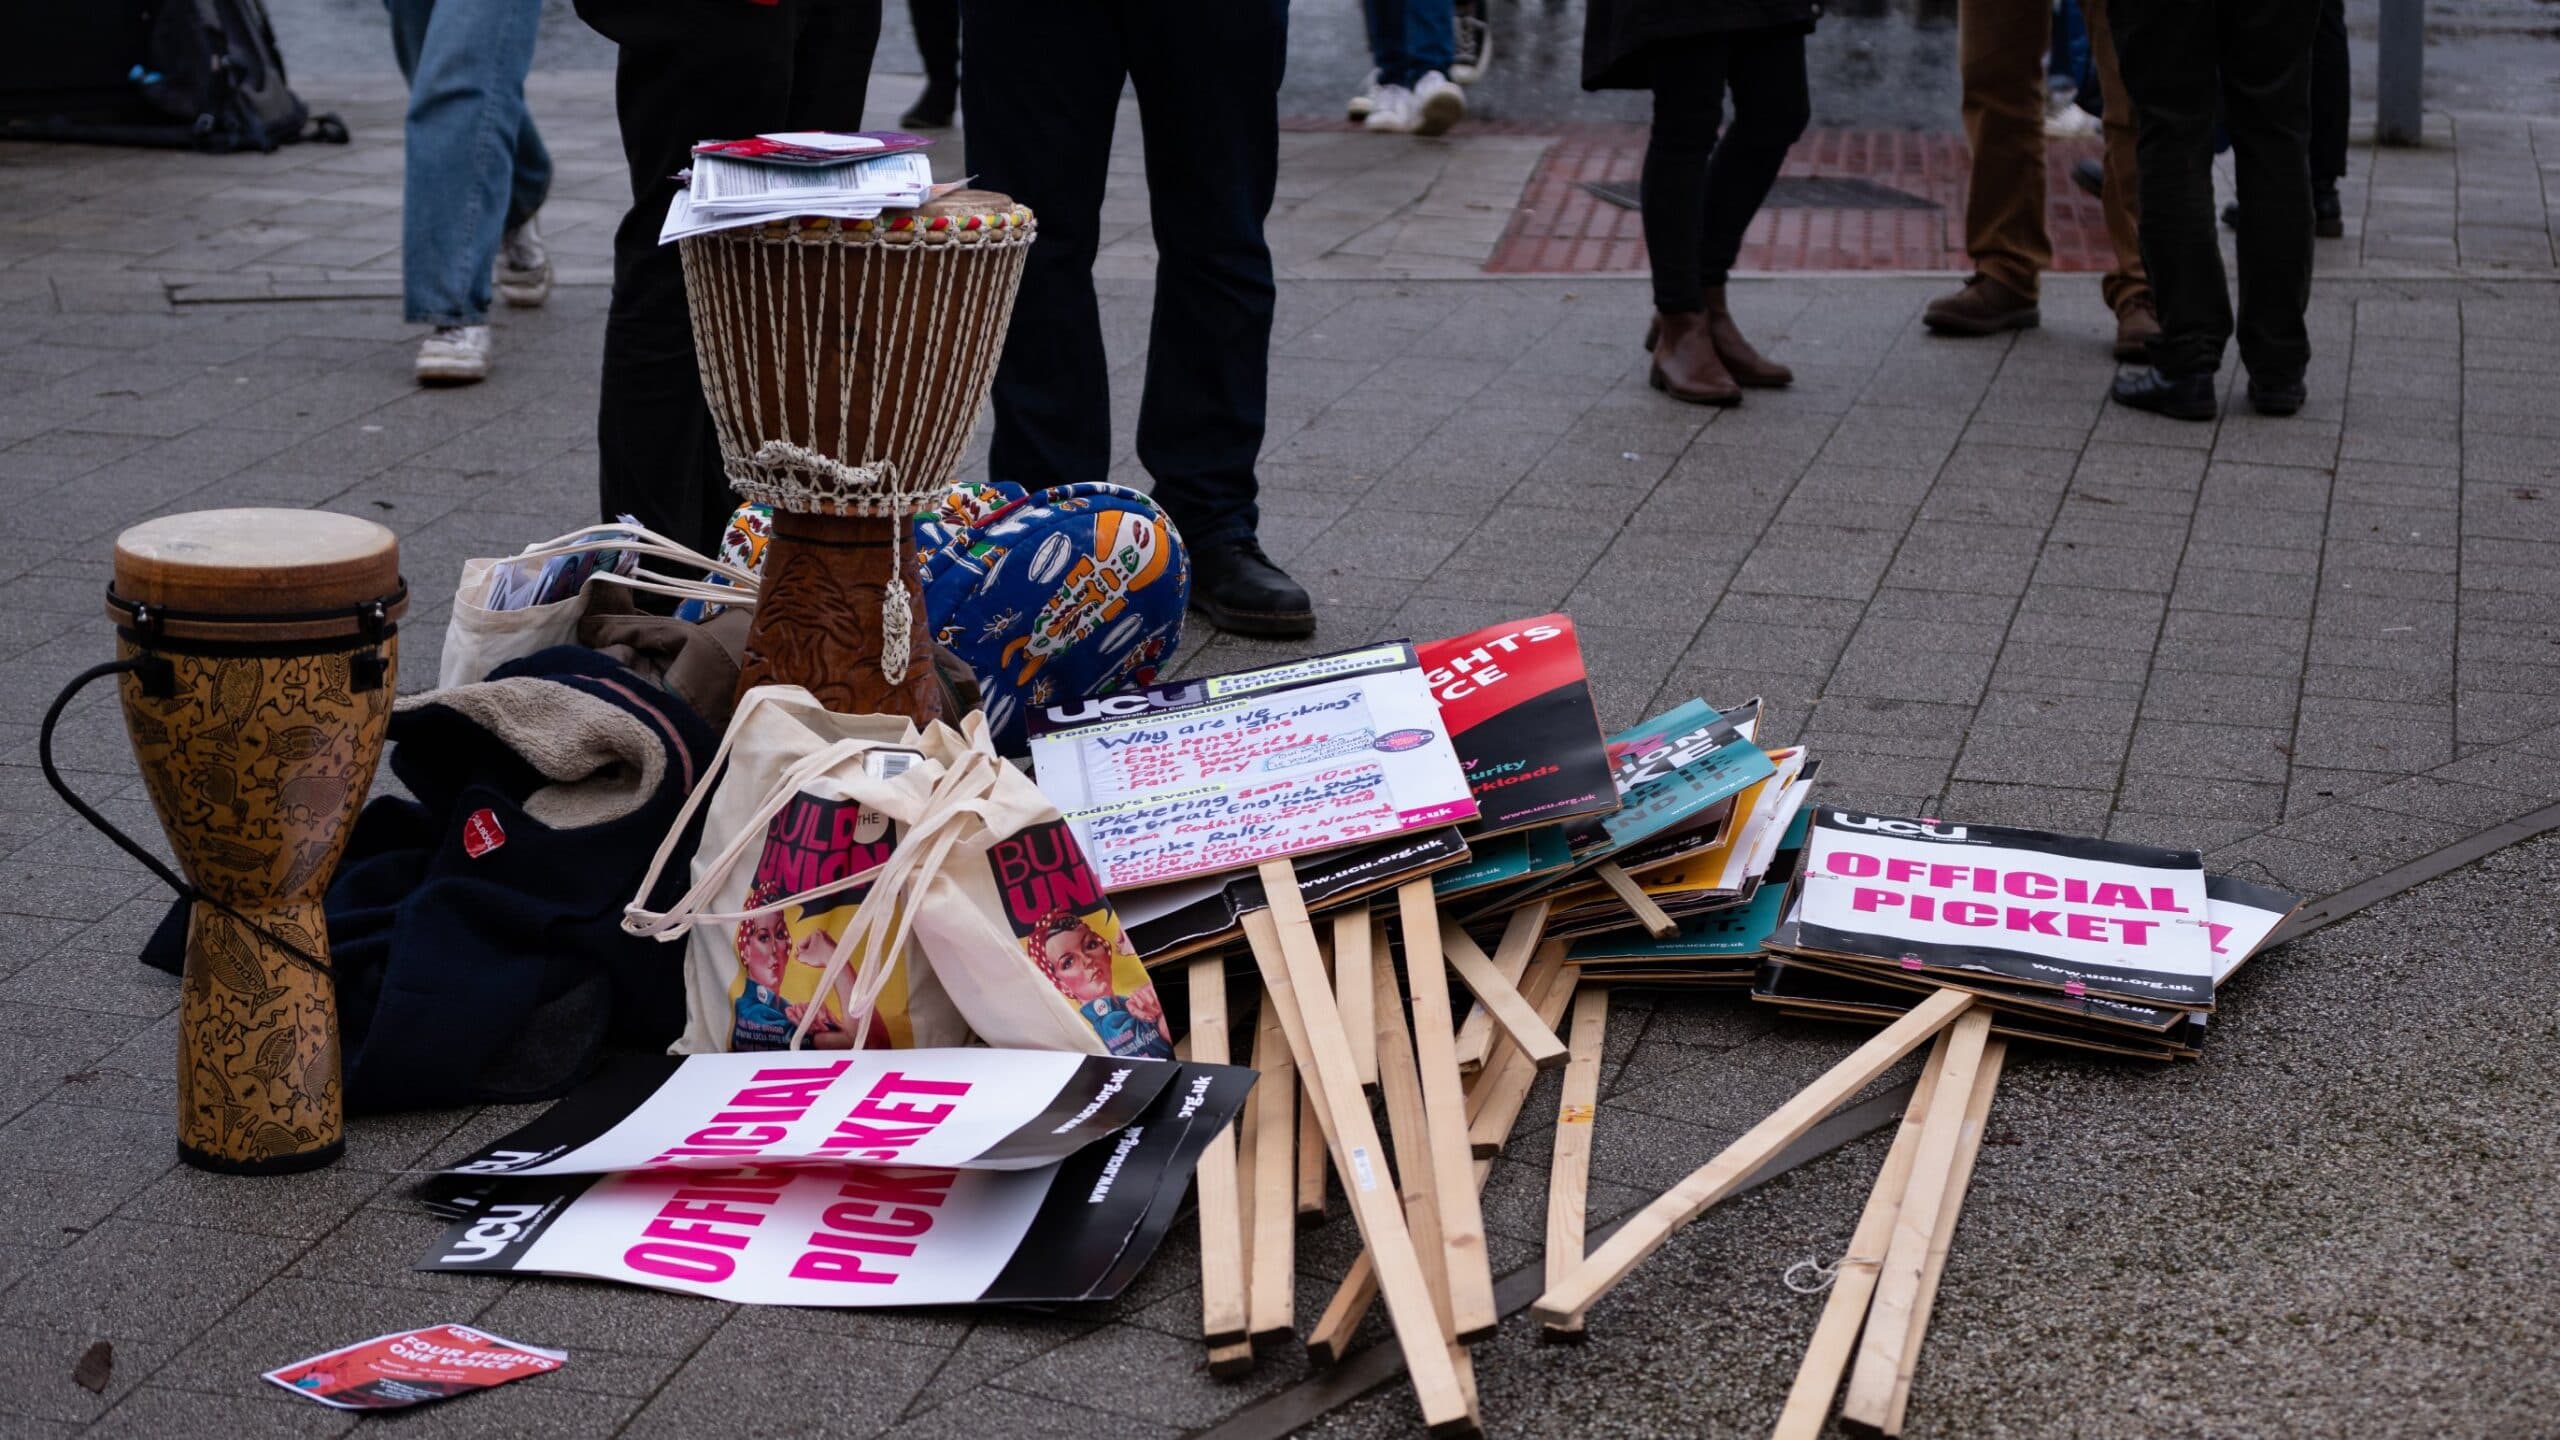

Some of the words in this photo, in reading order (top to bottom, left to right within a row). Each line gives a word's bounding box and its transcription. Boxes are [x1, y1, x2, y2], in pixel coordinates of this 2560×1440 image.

[1216, 668, 1303, 687] Trevor
[1307, 657, 1348, 670] the
[1217, 656, 1396, 695] Strikeosaurus
[1433, 665, 1508, 708] CE
[1053, 719, 1130, 740] Today's
[1135, 699, 1250, 725] Campaigns
[1096, 728, 1169, 750] Why
[1177, 717, 1226, 736] are
[857, 812, 880, 826] THE
[1063, 799, 1143, 819] Today's
[1150, 784, 1222, 802] Events
[1097, 794, 1229, 827] Picketing
[1500, 792, 1598, 822] www.ucu.org.uk
[1112, 841, 1195, 866] Strike
[1207, 824, 1275, 844] Rally
[1826, 850, 2190, 915] OFFICIAL
[1852, 886, 2161, 948] PICKET
[2031, 962, 2195, 993] www.ucu.org.uk
[645, 1060, 855, 1165] ICIAL
[1050, 1068, 1134, 1134] www.ucu.org.uk
[389, 1343, 437, 1362] ONE
[439, 1356, 515, 1370] VOICE
[402, 1336, 465, 1359] FOUR
[467, 1350, 554, 1370] FIGHTS
